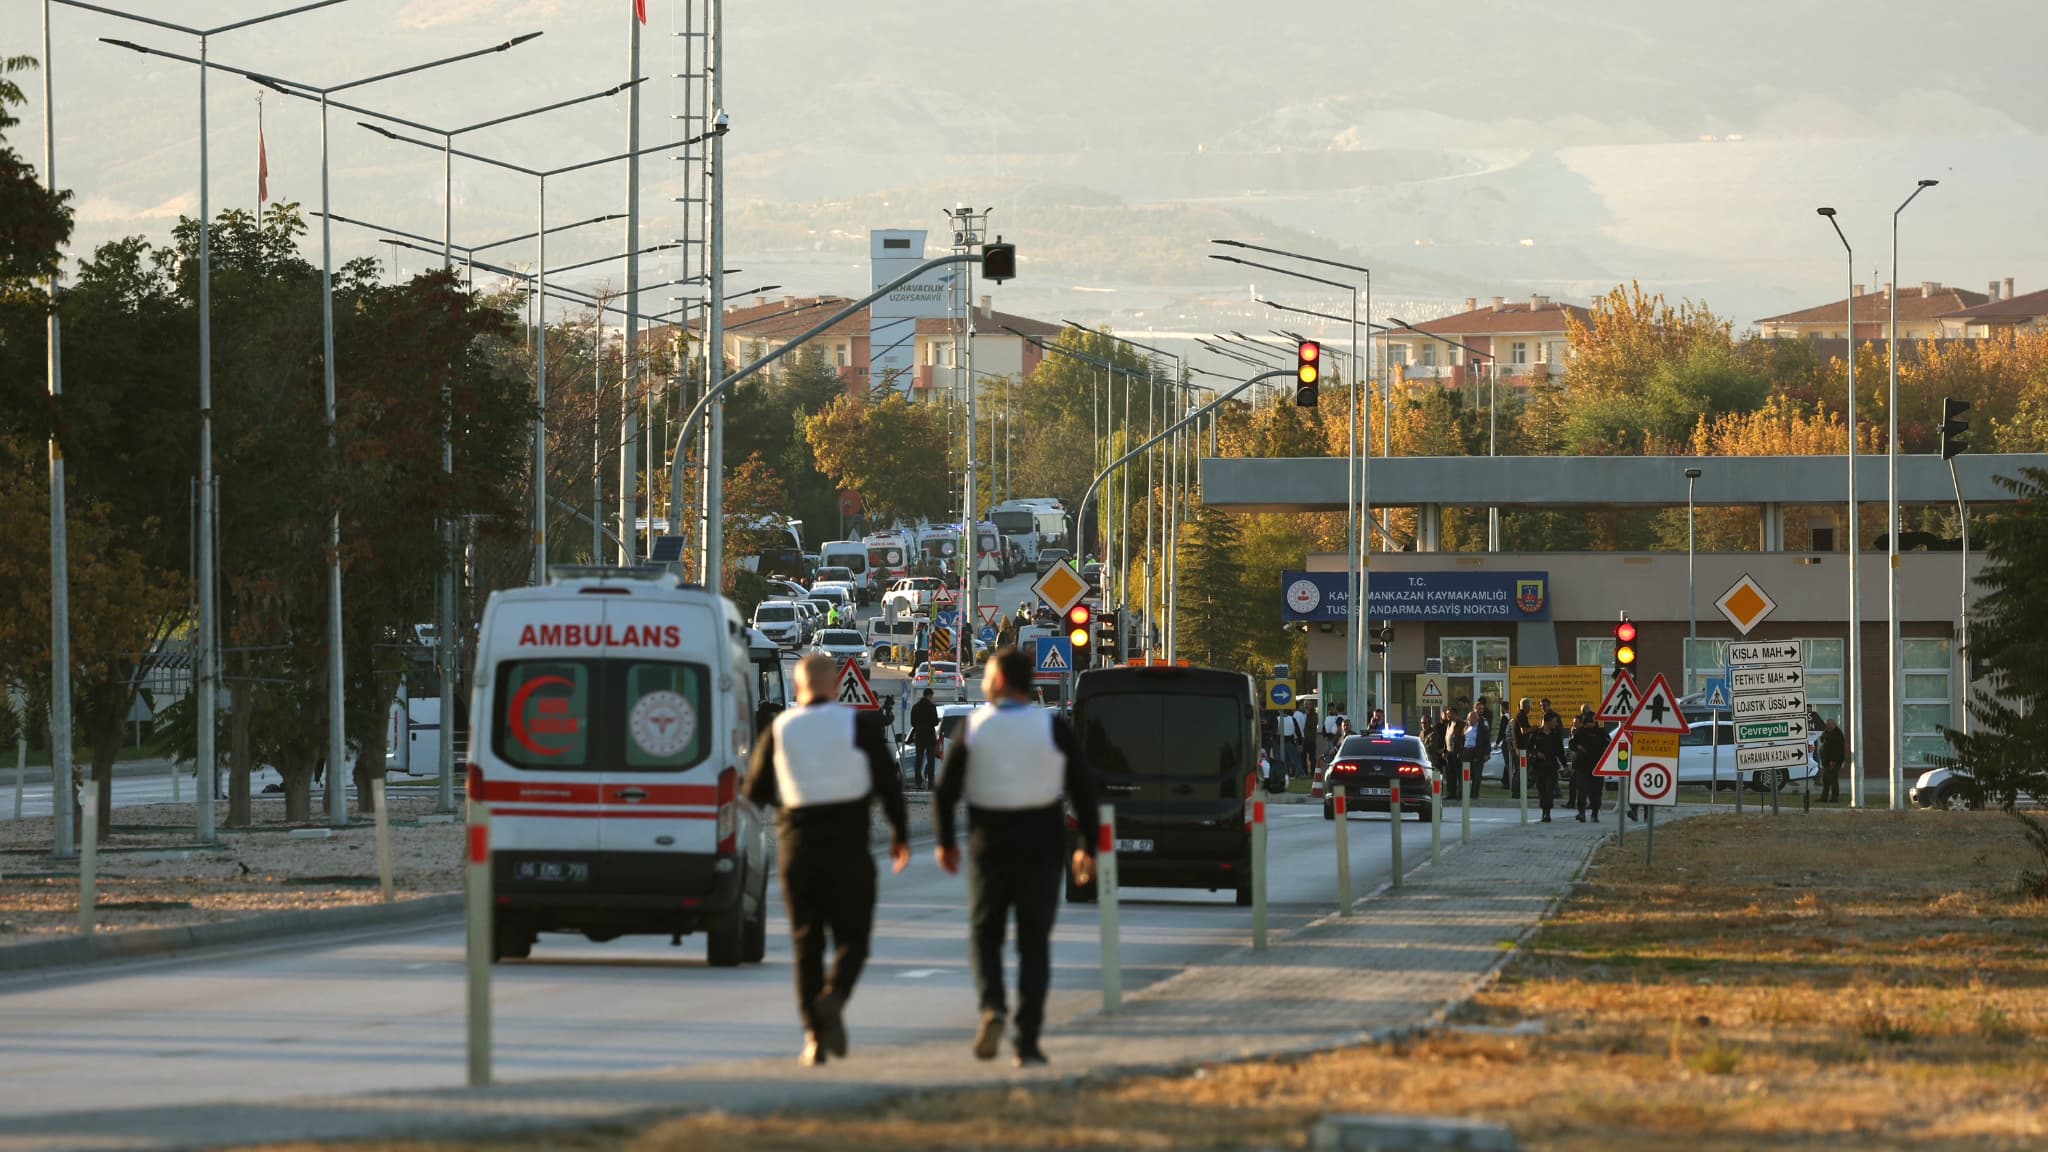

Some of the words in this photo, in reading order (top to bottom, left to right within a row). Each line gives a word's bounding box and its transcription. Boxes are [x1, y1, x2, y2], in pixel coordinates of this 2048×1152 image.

[1408, 577, 1427, 587] T.C.
[1329, 591, 1424, 600] KAHMANKAZAN
[1427, 588, 1507, 600] KAYMAKAMLIĞI
[1367, 604, 1421, 615] ANDARMA
[1423, 602, 1461, 616] ASAYİŞ
[1463, 605, 1509, 615] NOKTASI
[518, 624, 682, 648] AMBULANS
[1732, 647, 1759, 661] KIŞLA
[1762, 646, 1784, 658] MAH.
[1768, 696, 1788, 711] ÜSSÜ
[1740, 724, 1788, 739] Çevreyolu
[1643, 772, 1664, 789] 30
